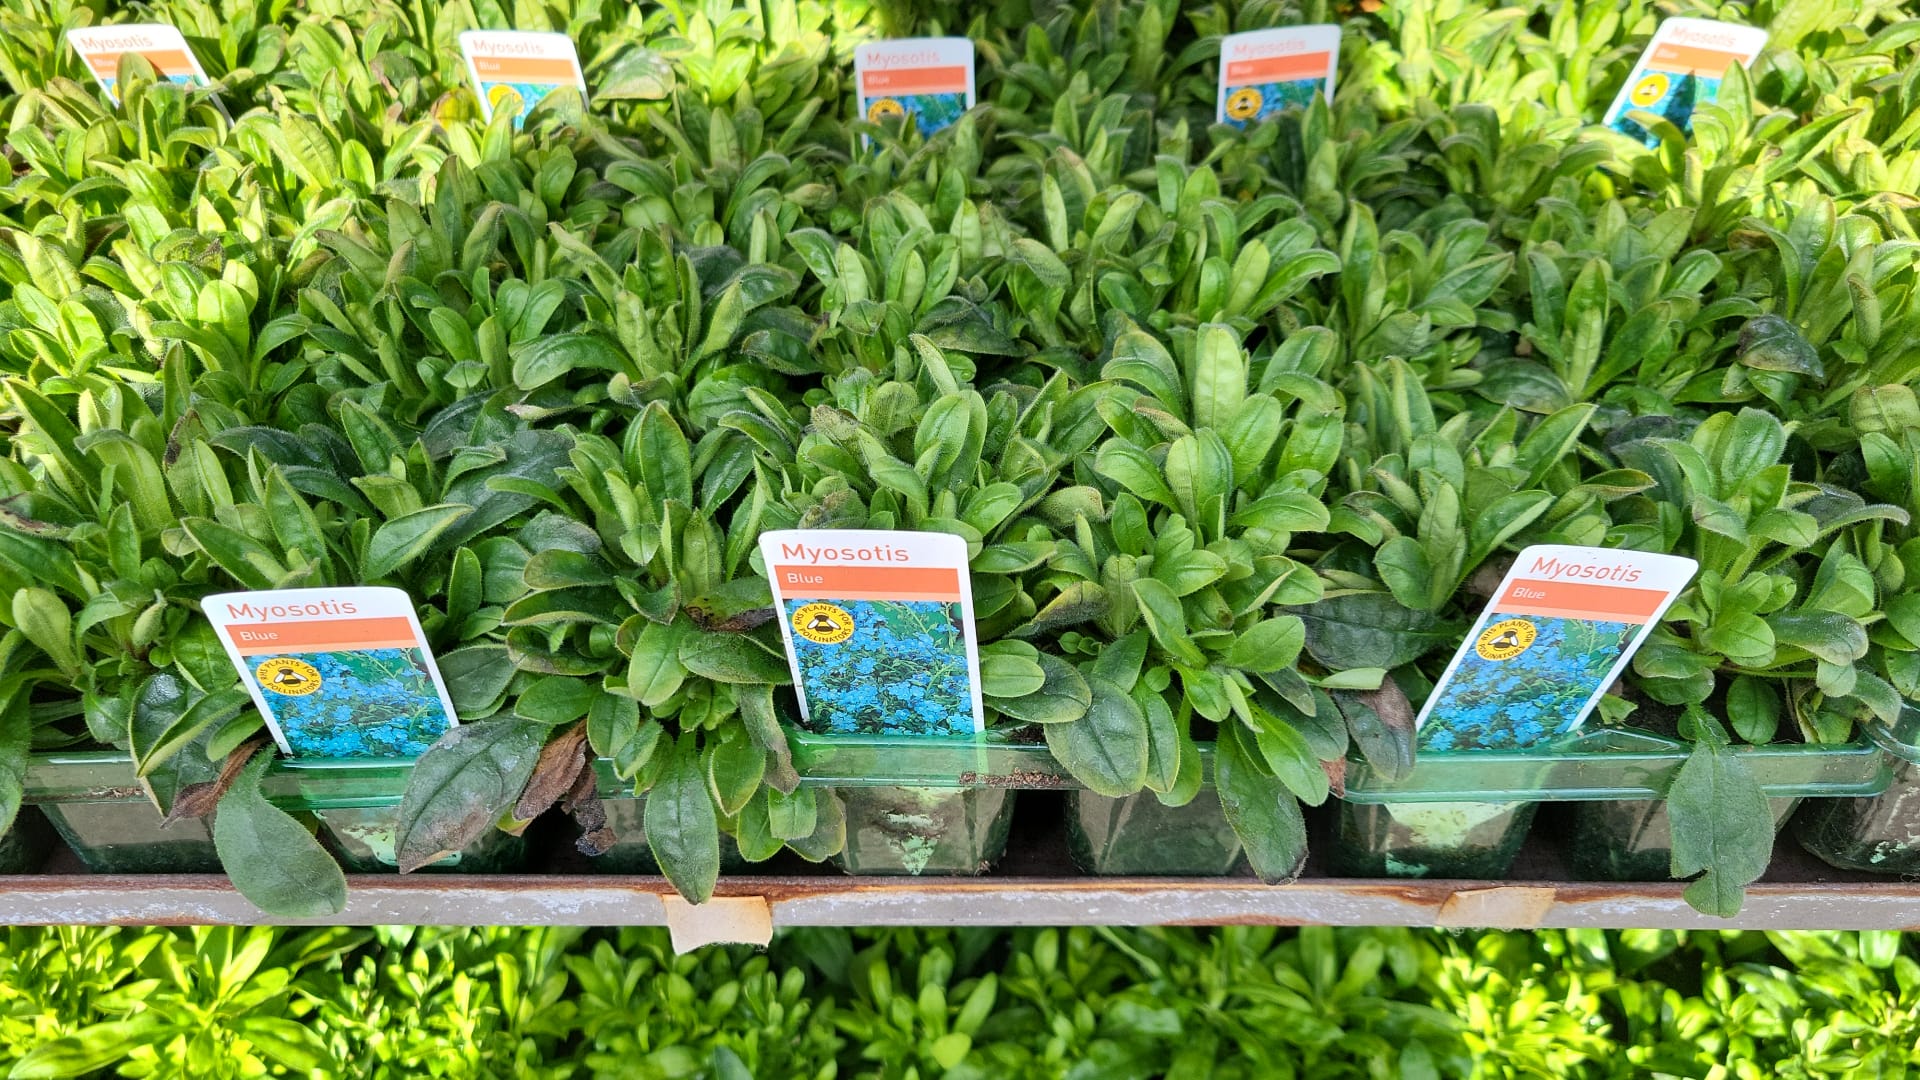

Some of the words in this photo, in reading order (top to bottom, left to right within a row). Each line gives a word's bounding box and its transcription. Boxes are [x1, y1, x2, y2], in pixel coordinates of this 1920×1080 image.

[82, 34, 154, 51] Myosotis
[472, 39, 545, 56] Myosotis
[867, 48, 941, 70] Myosotis
[781, 543, 909, 564] Myosotis
[1529, 556, 1643, 583] Myosotis
[786, 572, 824, 585] Blue
[1511, 586, 1547, 600] Blue
[226, 599, 358, 622] Myosotis
[794, 612, 805, 625] RHS
[802, 604, 839, 614] PLANTS
[838, 613, 852, 626] FOR
[1499, 620, 1531, 631] PLANTS
[239, 631, 279, 642] Blue
[798, 627, 852, 643] POLLINATORS
[264, 659, 300, 669] PLANTS
[302, 665, 318, 677] FOR
[266, 679, 320, 695] POLLINATORS
